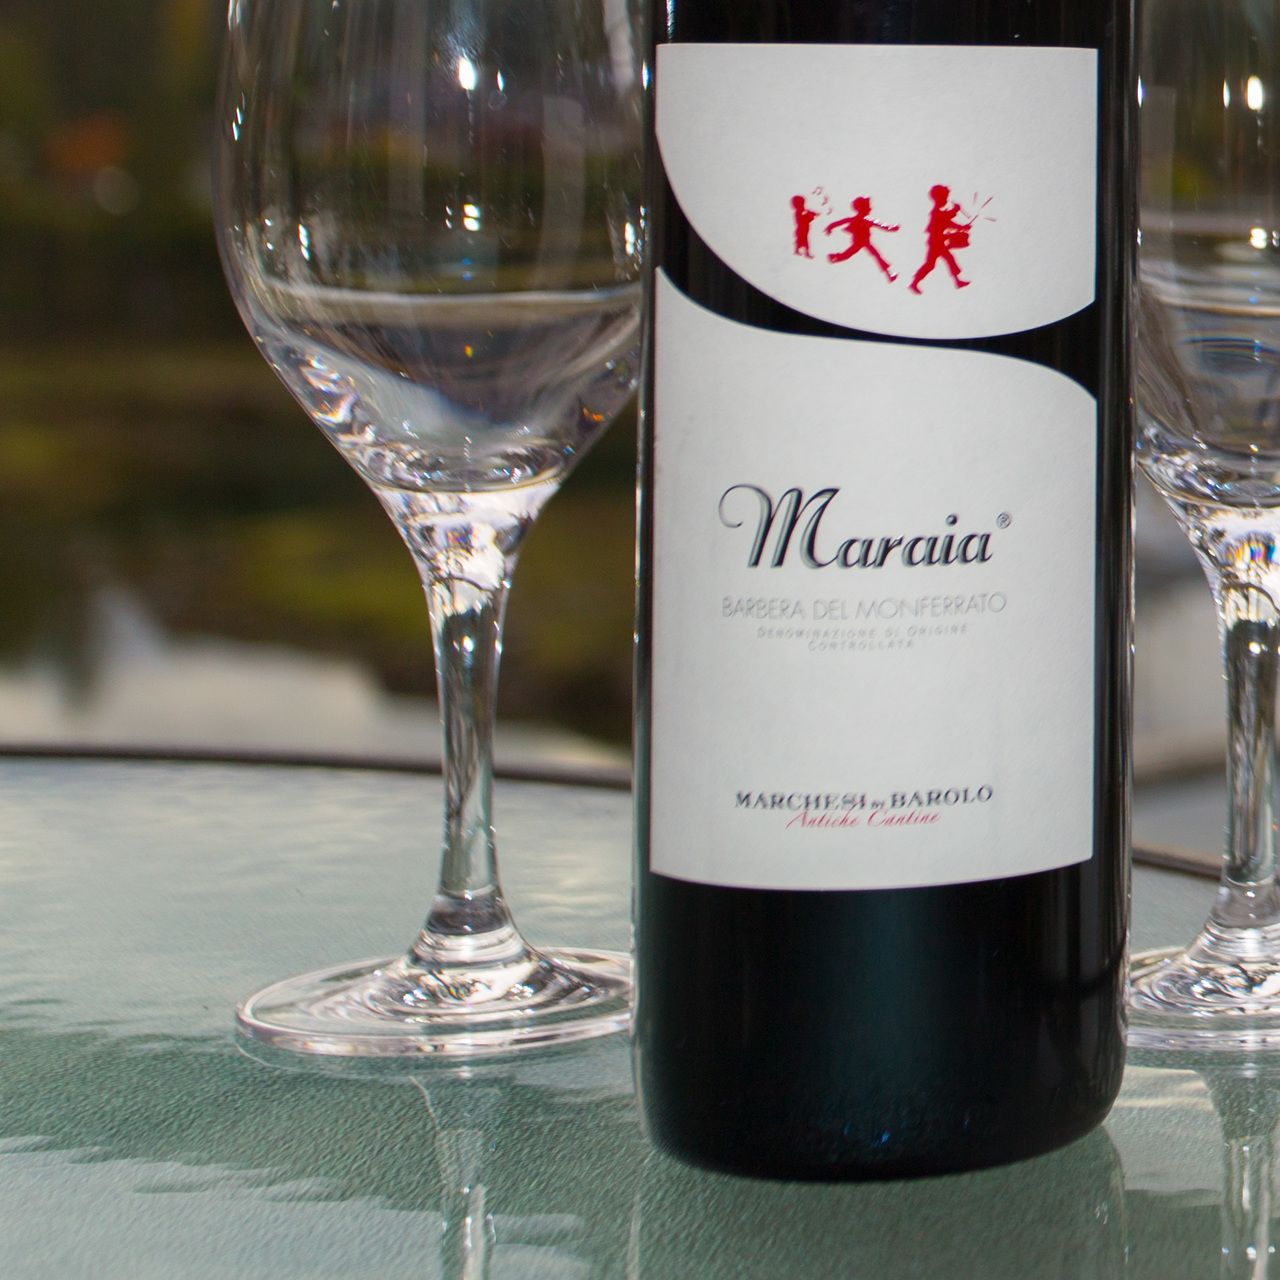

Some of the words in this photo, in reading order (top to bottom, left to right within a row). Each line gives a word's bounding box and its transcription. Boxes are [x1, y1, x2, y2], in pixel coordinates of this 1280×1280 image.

[722, 596, 804, 620] BARBERA
[813, 599, 849, 621] DEL
[854, 591, 1007, 620] MONFERRATO
[734, 790, 867, 811] MARCHESI
[889, 784, 994, 809] BAROLO
[867, 806, 942, 827] Cantine
